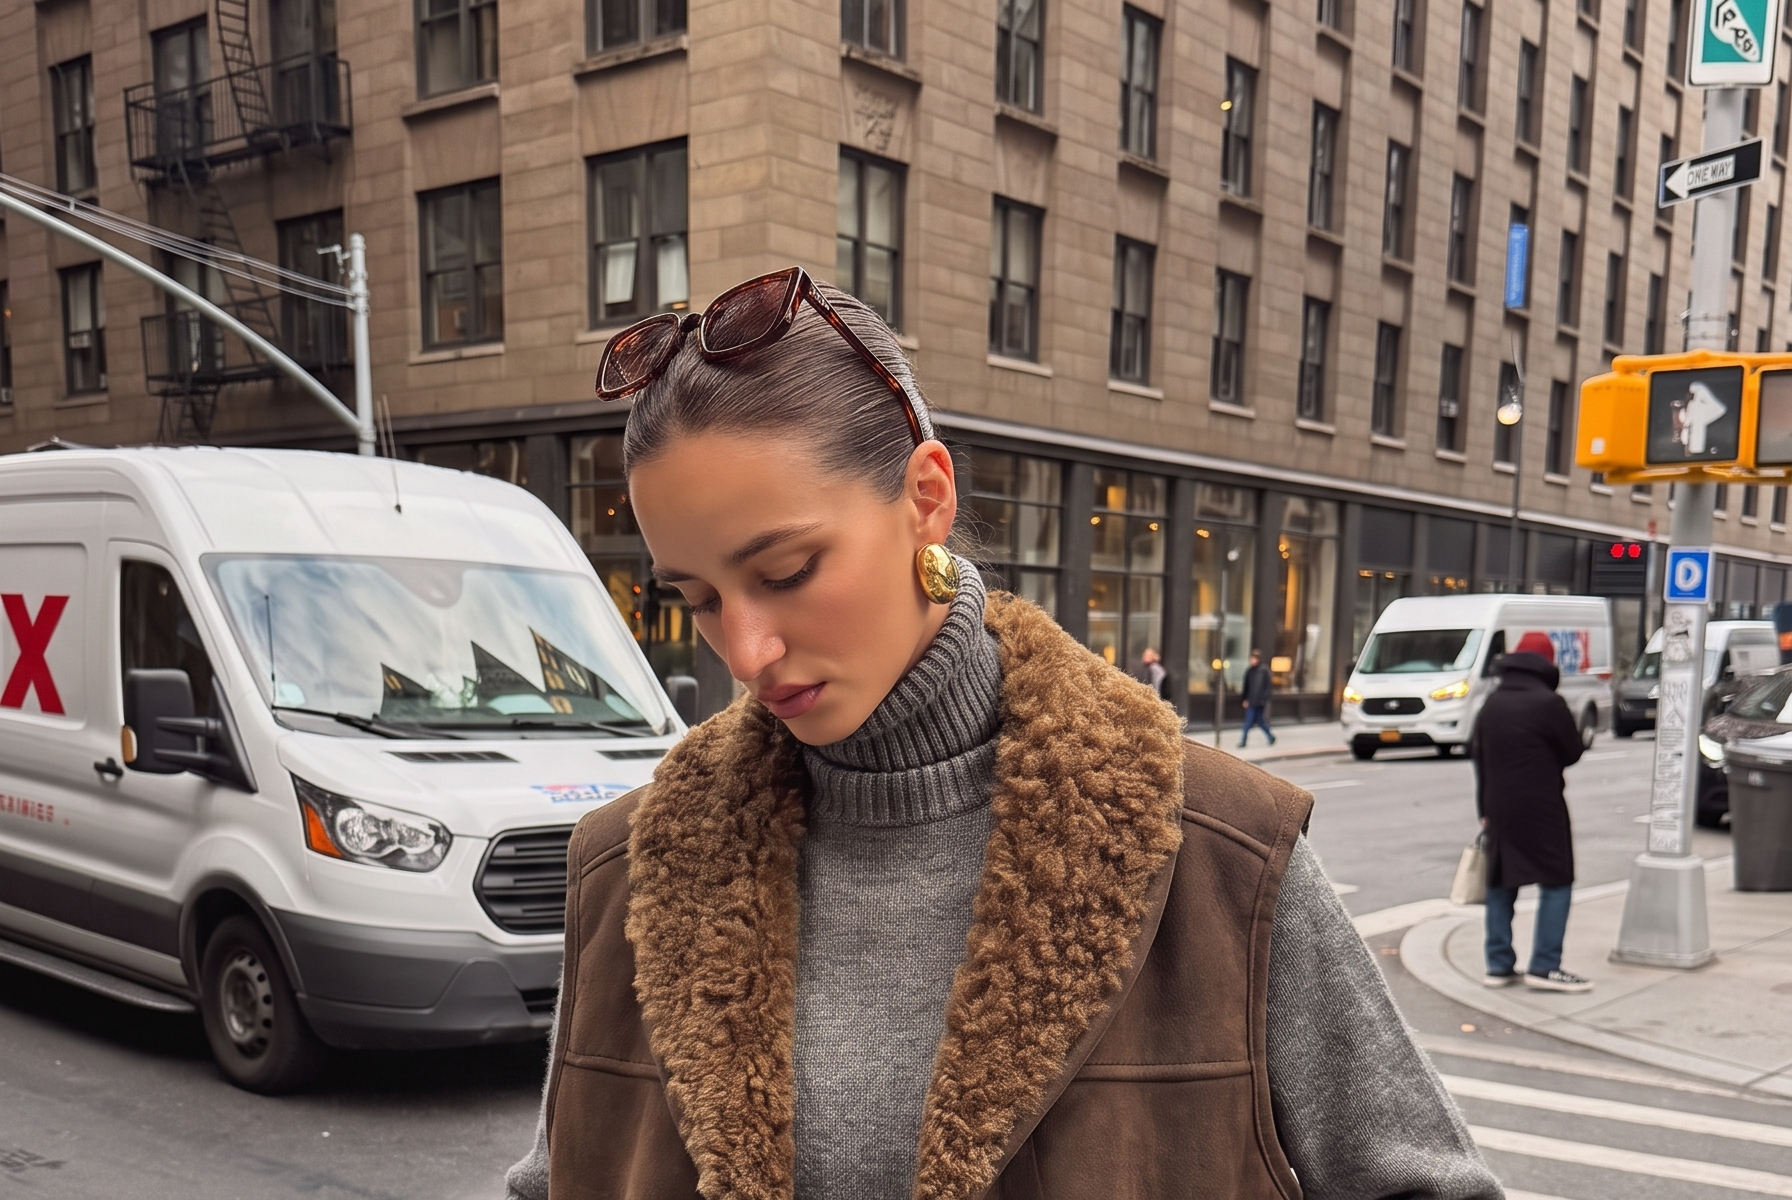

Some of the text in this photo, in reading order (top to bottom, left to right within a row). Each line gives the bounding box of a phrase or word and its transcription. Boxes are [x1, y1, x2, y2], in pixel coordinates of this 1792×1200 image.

[1687, 161, 1731, 186] ONE WAY
[0, 594, 70, 716] X
